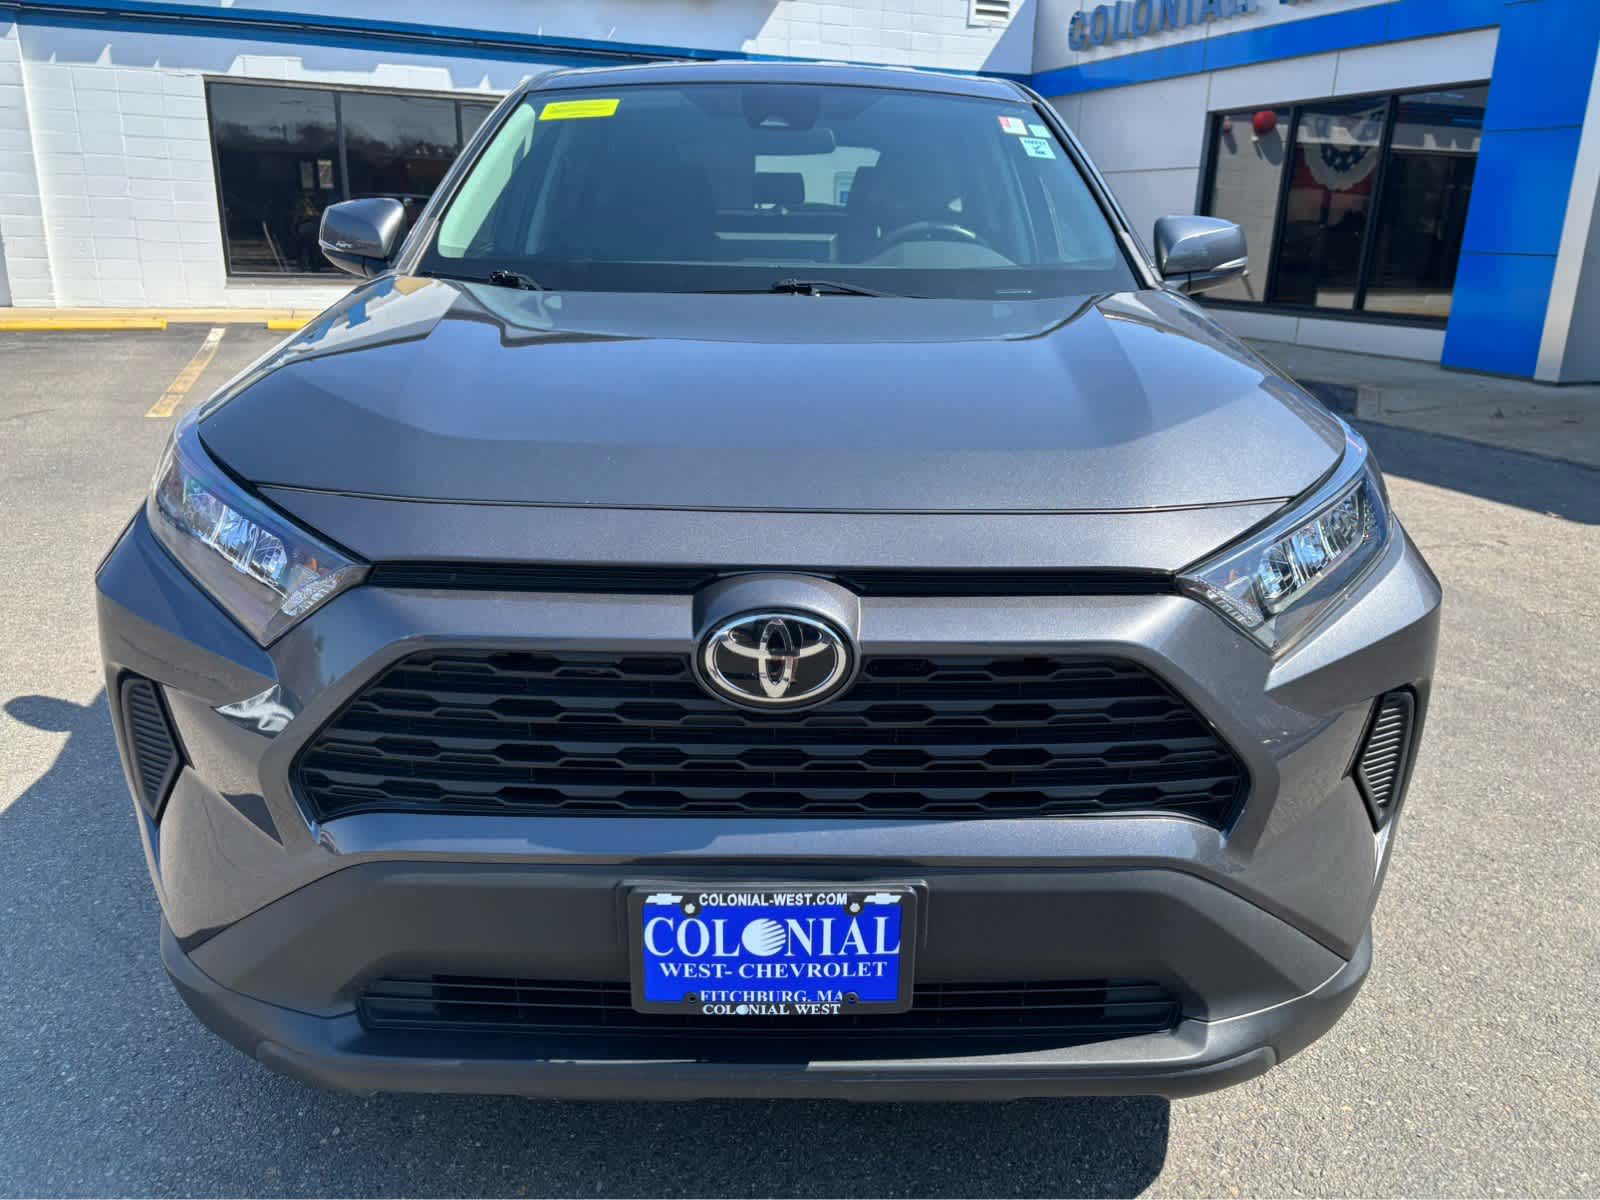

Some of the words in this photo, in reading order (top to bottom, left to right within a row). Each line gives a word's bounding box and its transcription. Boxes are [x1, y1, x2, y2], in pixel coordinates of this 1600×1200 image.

[1068, 0, 1250, 50] COLONIA
[698, 893, 848, 906] COLONIAL-WEST.COM
[643, 915, 901, 957] COLONIAL
[738, 961, 888, 979] CHEVROLET
[816, 989, 844, 1002] MA
[702, 1003, 790, 1016] COLONIAL
[794, 1003, 841, 1016] WEST
